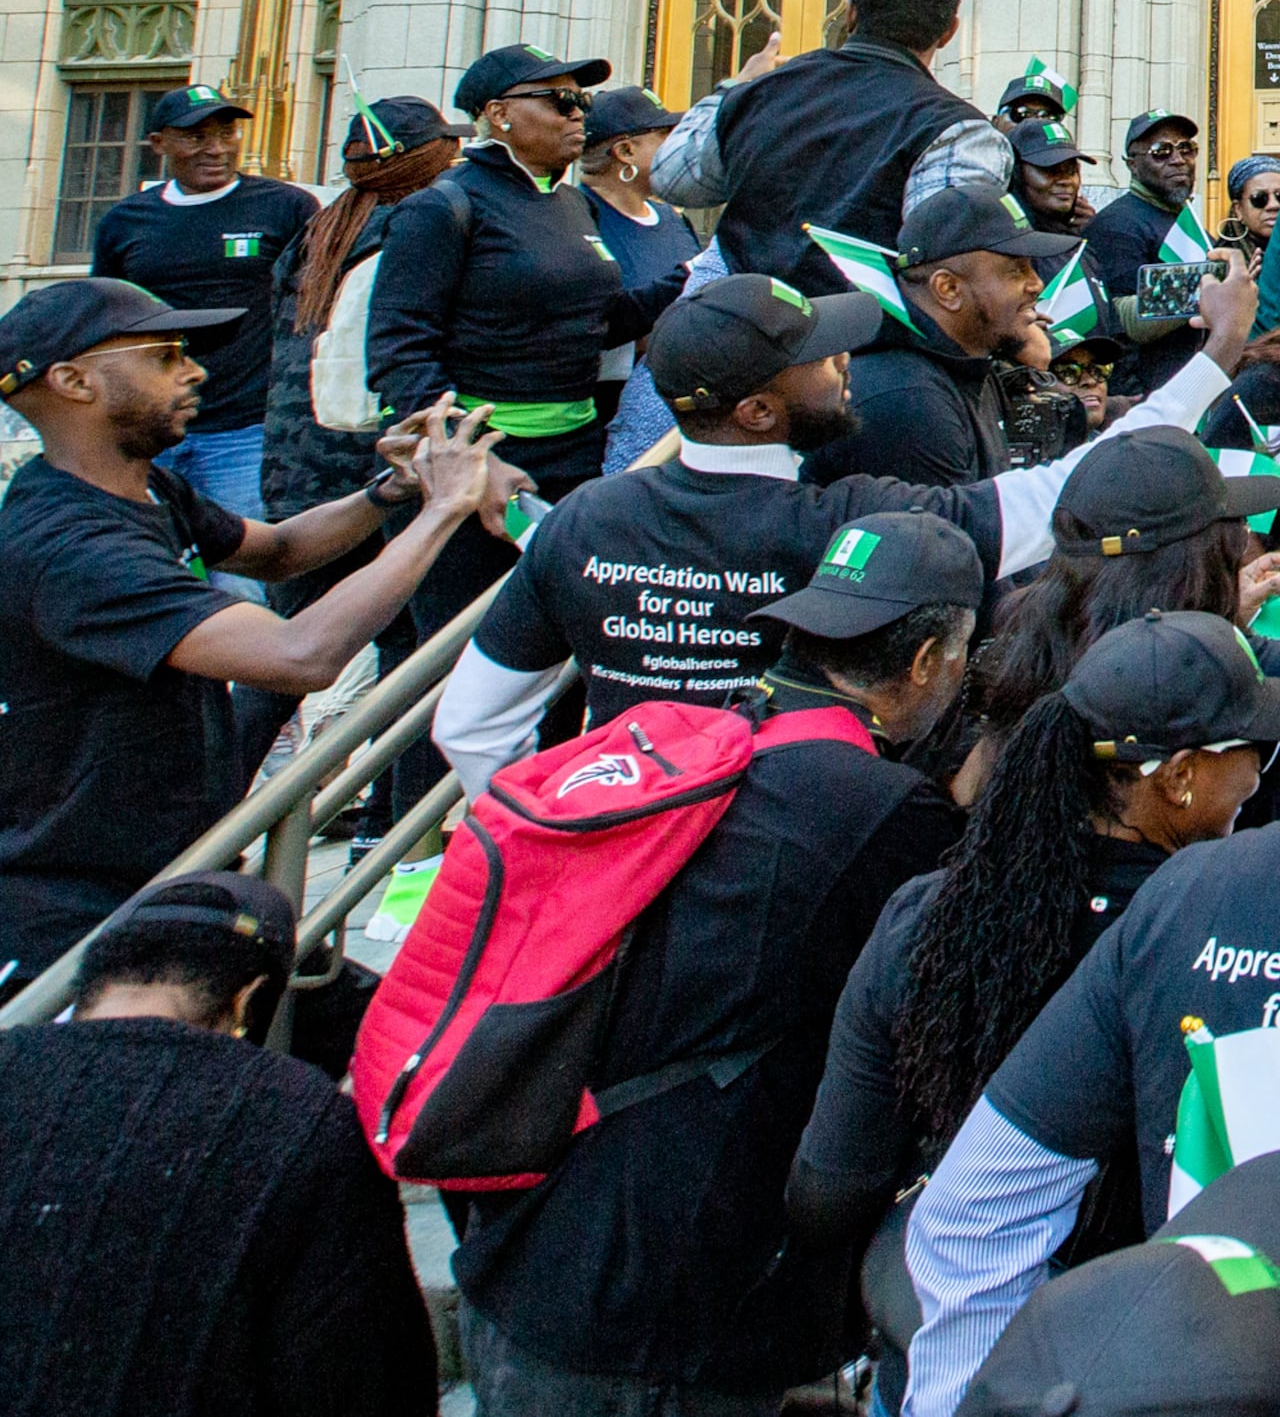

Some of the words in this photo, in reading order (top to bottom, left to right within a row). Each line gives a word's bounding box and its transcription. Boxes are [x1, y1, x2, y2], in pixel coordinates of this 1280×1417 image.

[583, 555, 720, 590] Appreciation
[724, 570, 786, 594] Walk
[850, 570, 866, 583] 62
[638, 590, 672, 614] for
[674, 599, 714, 617] our
[602, 615, 674, 643] Global
[678, 623, 761, 646] Heroes
[642, 655, 739, 671] #globalheroes
